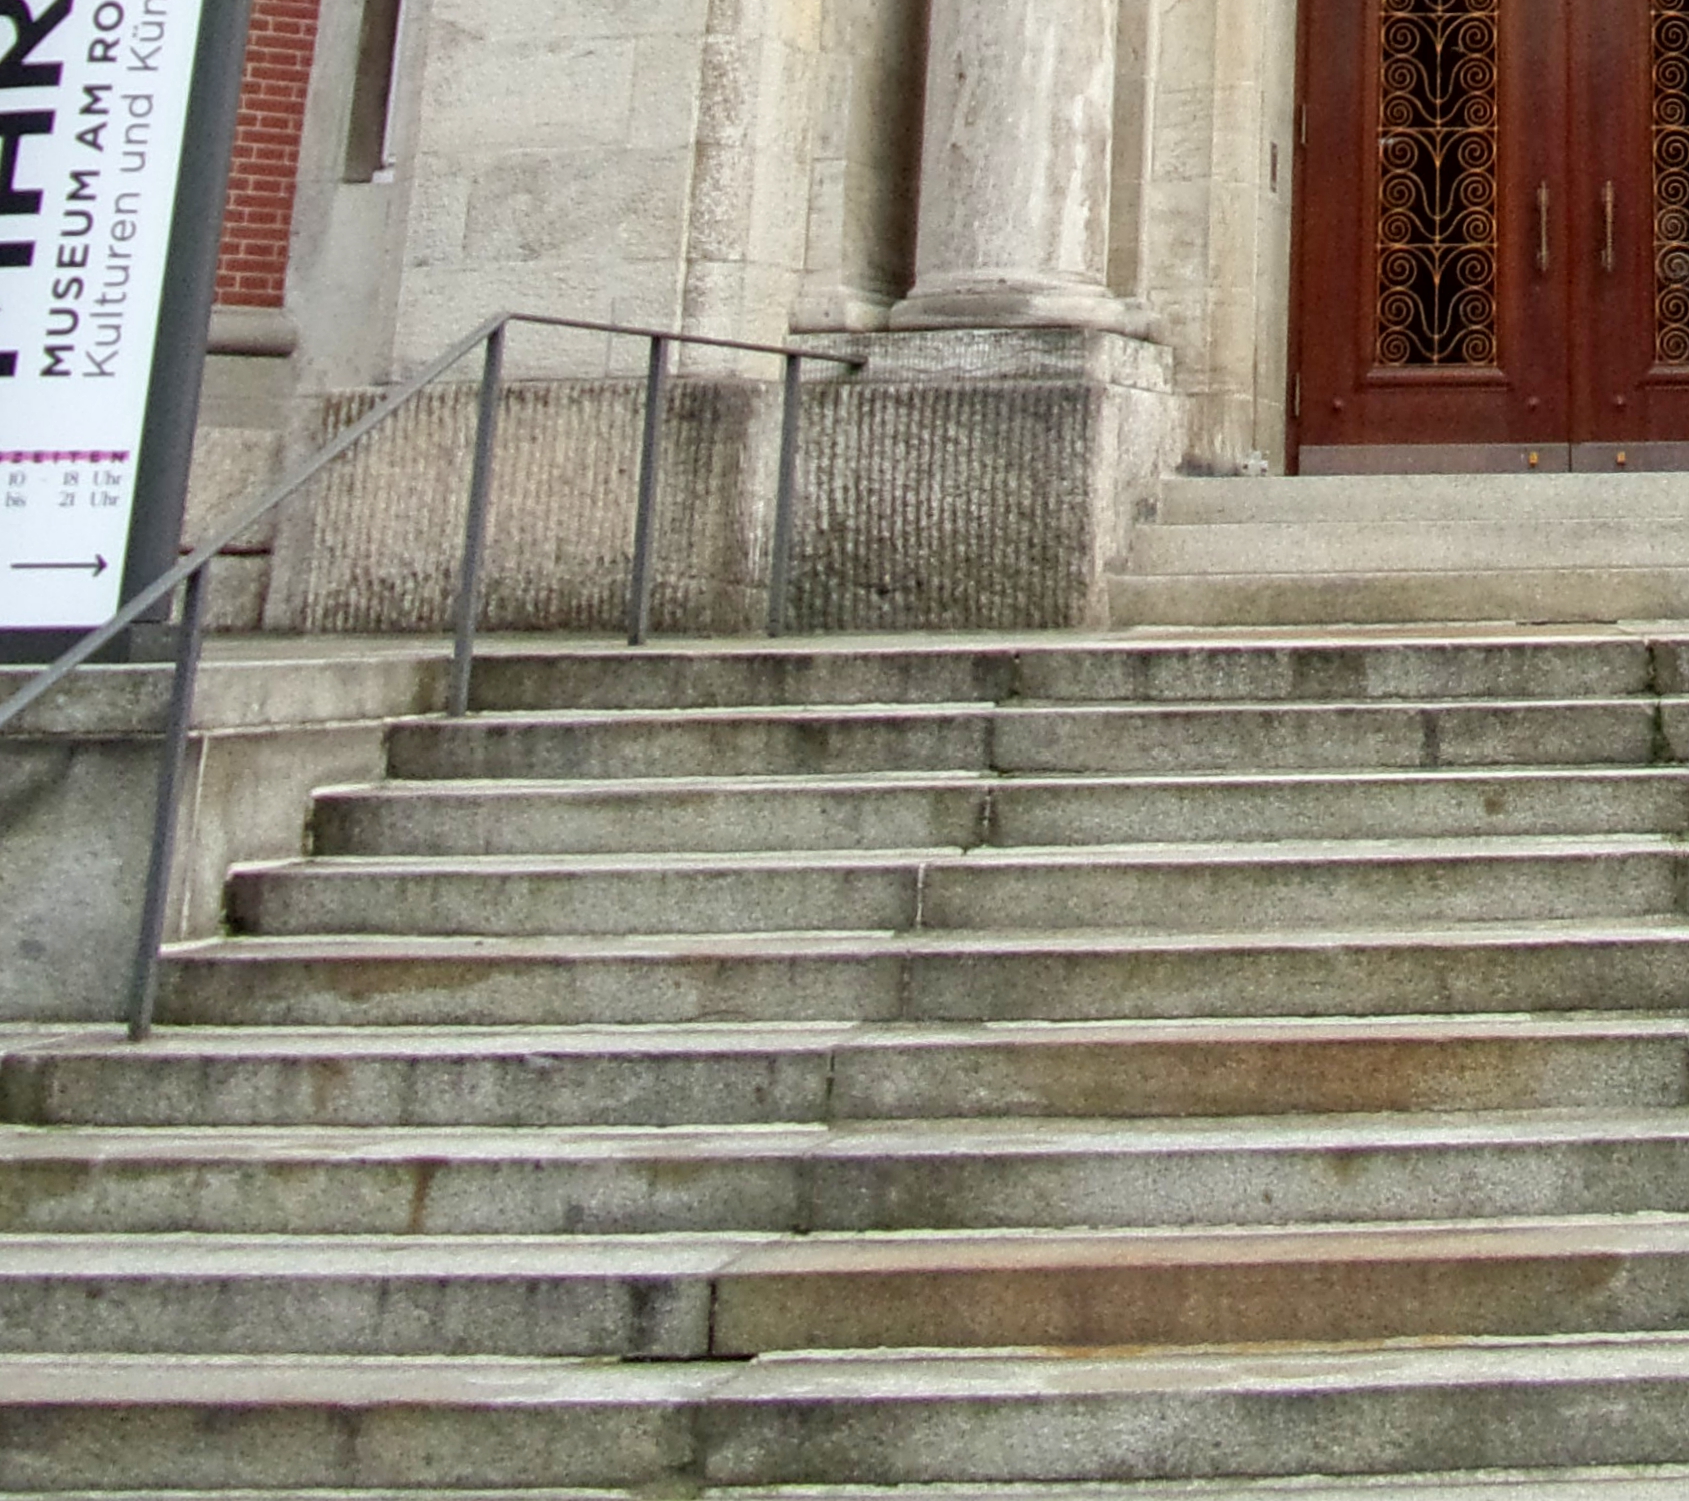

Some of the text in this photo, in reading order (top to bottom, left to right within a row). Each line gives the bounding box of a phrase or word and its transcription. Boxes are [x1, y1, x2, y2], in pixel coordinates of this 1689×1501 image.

[39, 171, 101, 377] MUSEUM
[75, 84, 113, 152] AM
[83, 192, 141, 377] Kulturen
[120, 94, 154, 173] und
[5, 491, 26, 507] bis
[90, 491, 119, 507] Uhr
[93, 470, 121, 486] Uhr
